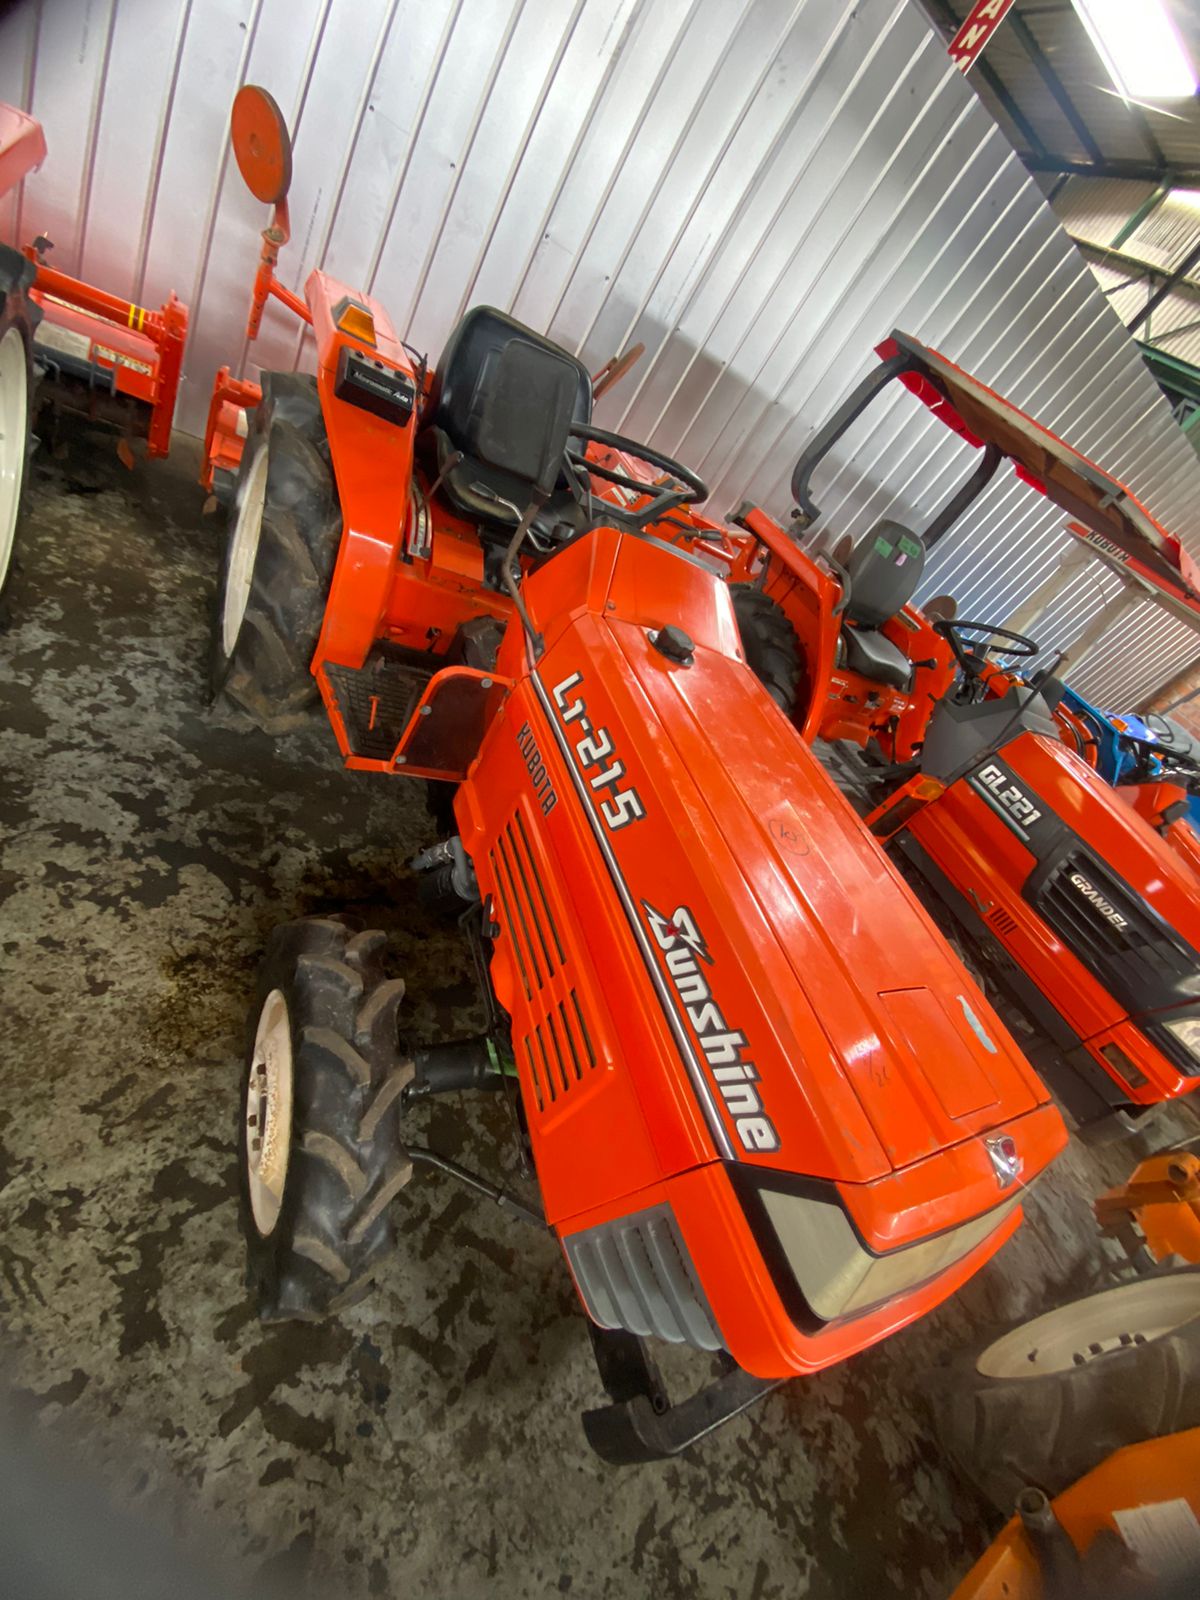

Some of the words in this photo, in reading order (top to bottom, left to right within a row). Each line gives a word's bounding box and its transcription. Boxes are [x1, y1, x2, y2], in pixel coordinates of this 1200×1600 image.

[516, 720, 559, 817] KUBOTA
[977, 764, 1042, 827] GL221
[1070, 873, 1129, 933] GRANDEL
[640, 897, 783, 1153] Sunshine
